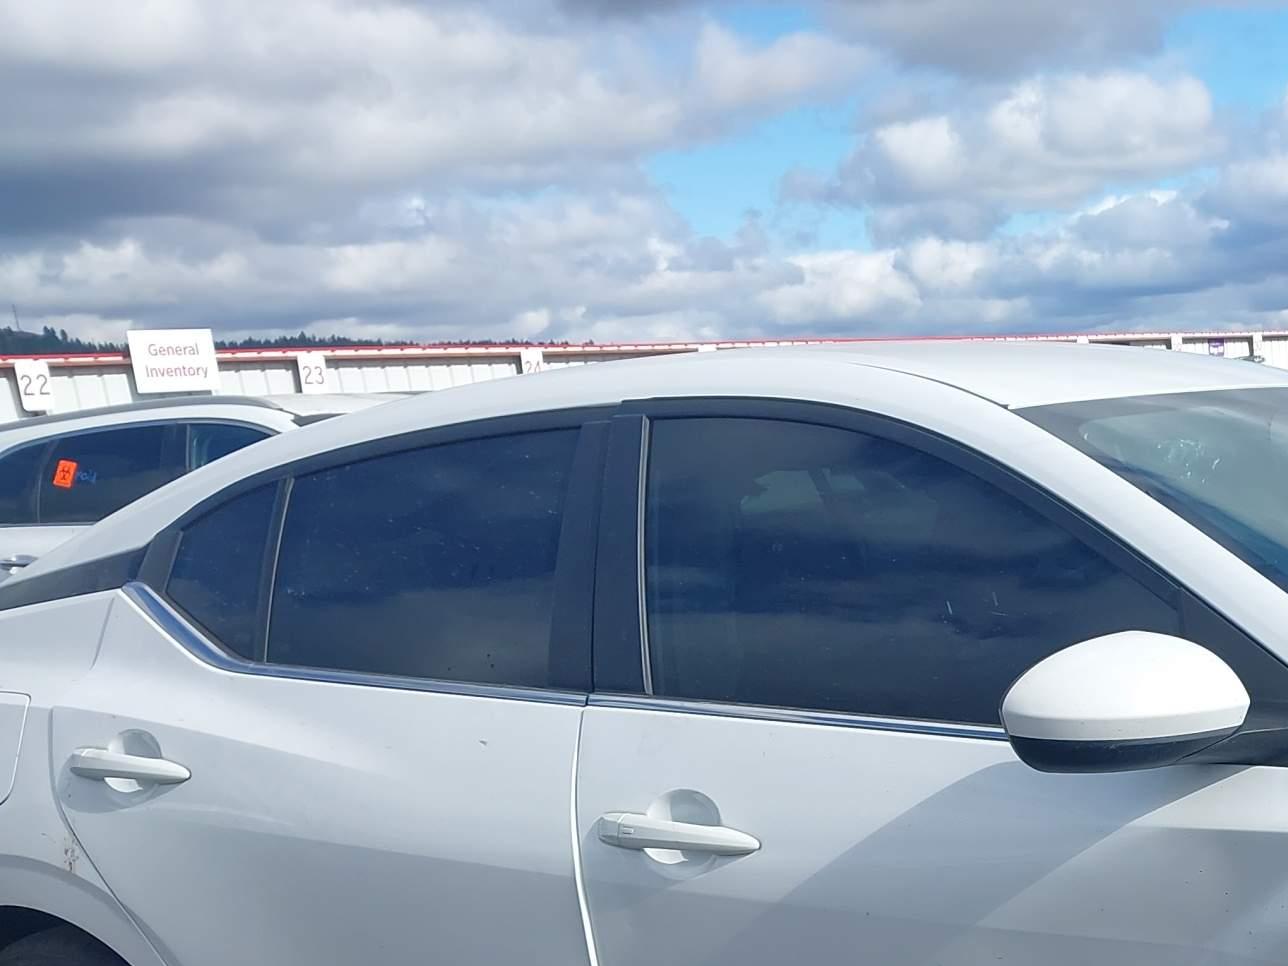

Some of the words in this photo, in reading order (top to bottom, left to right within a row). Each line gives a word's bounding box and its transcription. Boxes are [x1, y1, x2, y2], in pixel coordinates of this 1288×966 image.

[148, 342, 200, 357] General
[145, 364, 208, 379] Inventory
[302, 365, 325, 385] 23
[20, 374, 51, 396] 22
